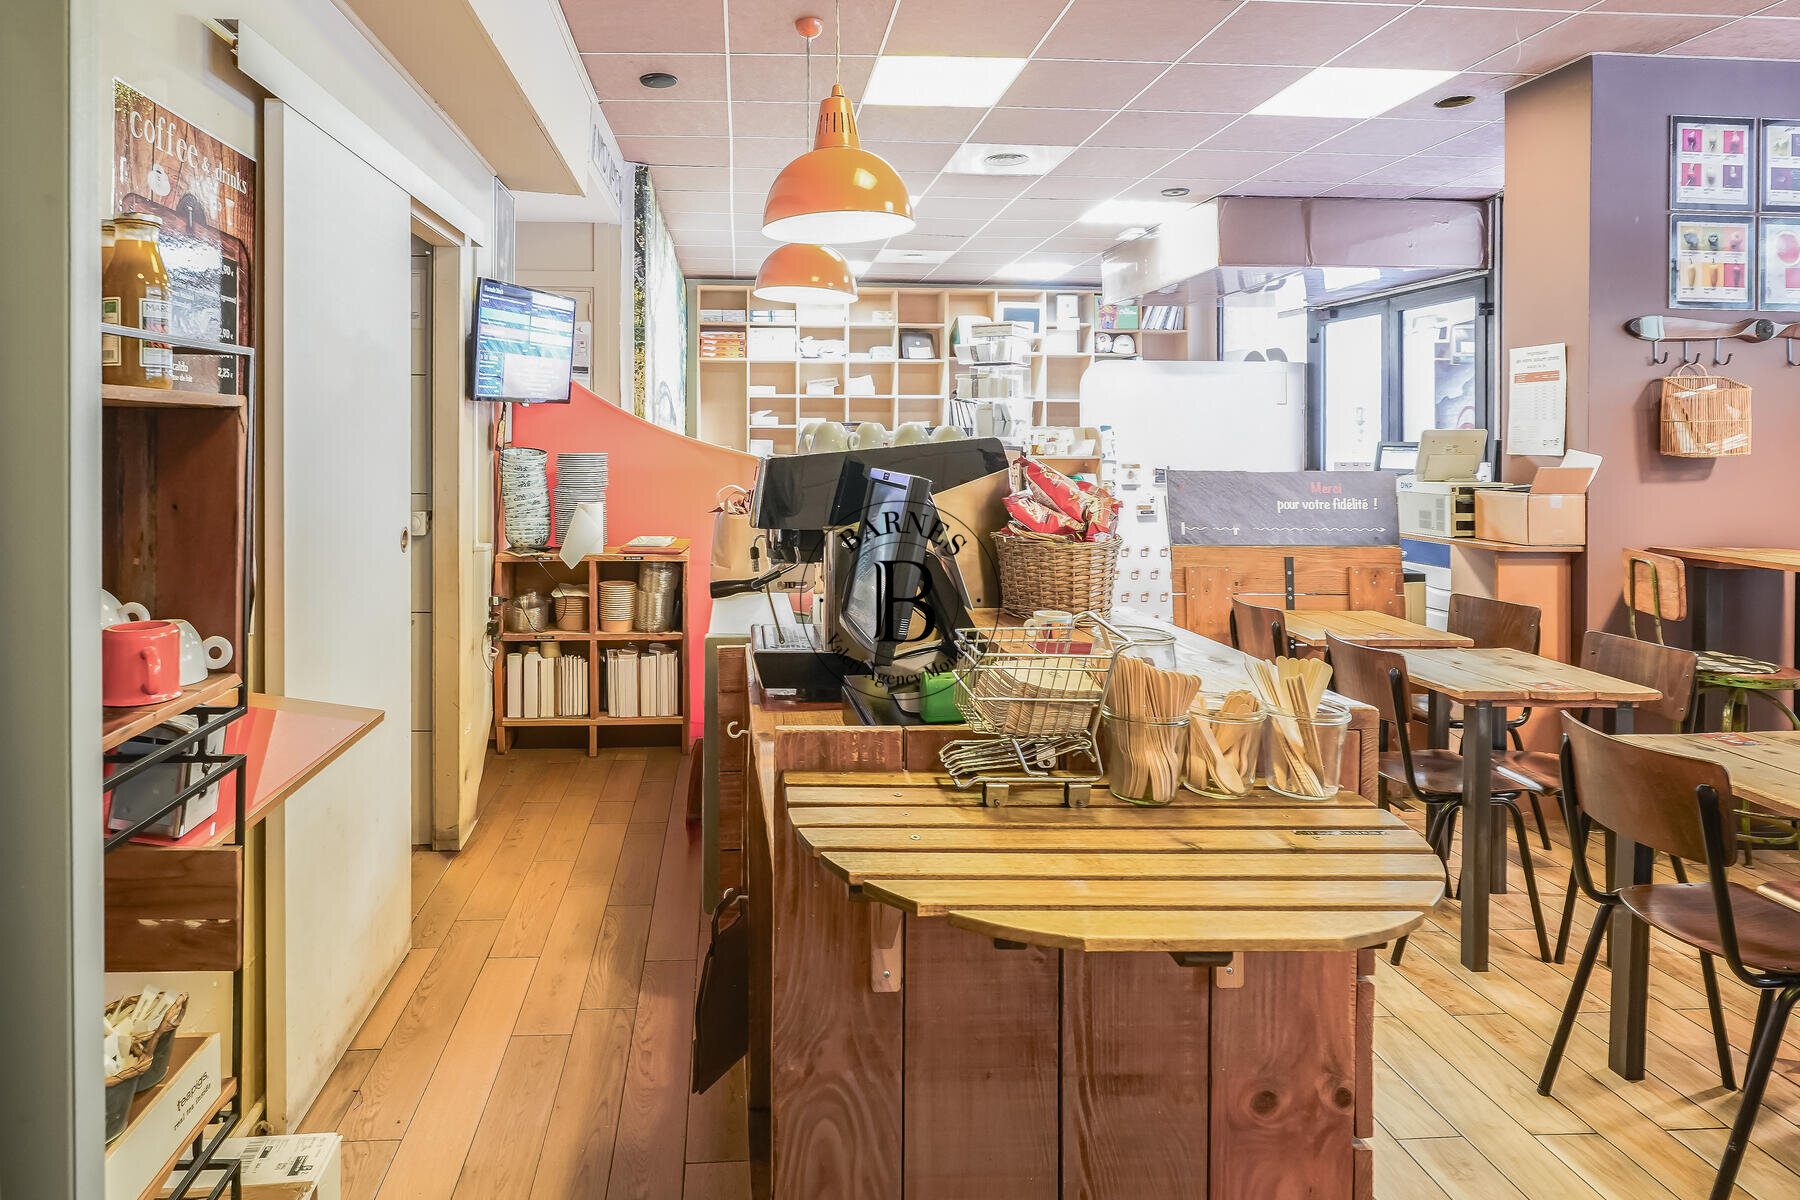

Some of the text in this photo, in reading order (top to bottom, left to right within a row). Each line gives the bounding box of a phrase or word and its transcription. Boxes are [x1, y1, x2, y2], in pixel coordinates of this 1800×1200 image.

[201, 157, 211, 172] &
[215, 162, 247, 195] drinks
[1311, 481, 1342, 494] Merci
[1400, 481, 1414, 489] DNP
[1277, 500, 1300, 513] pour
[1302, 499, 1331, 510] votre
[1332, 497, 1368, 510] fidélité
[174, 1113, 185, 1131] real
[186, 1104, 195, 1116] tea
